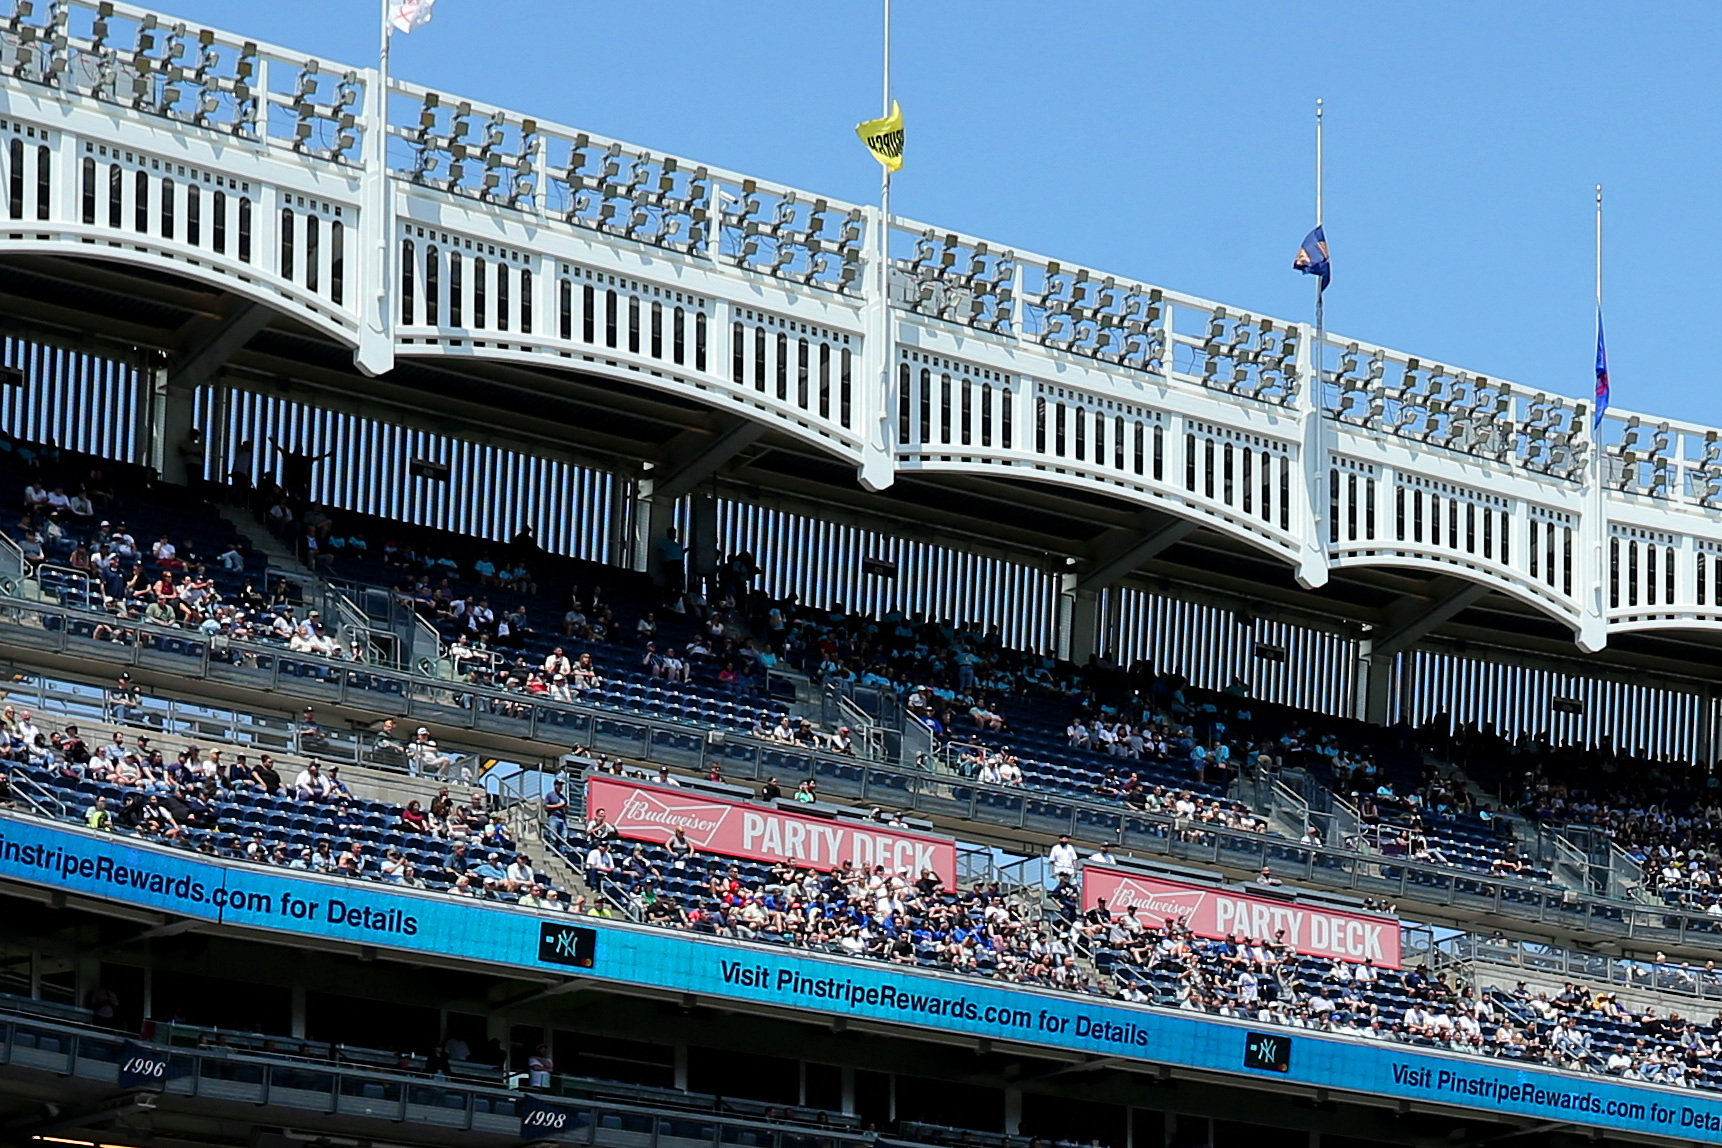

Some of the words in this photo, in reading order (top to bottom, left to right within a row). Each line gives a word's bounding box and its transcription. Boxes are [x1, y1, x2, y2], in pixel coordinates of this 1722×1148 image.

[624, 797, 717, 833] Budweiser
[743, 812, 845, 867] PARTY
[848, 832, 936, 880] DECK
[281, 892, 319, 921] for
[326, 899, 418, 936] Details
[1112, 886, 1195, 923] Budweiser
[1216, 897, 1302, 945] PARTY
[1311, 913, 1383, 960] DECK
[720, 960, 770, 989] Visit
[776, 968, 1031, 1029] PinstripeRewards.com
[1038, 1008, 1068, 1035] for
[1075, 1014, 1149, 1046] Details
[122, 1056, 166, 1077] 1996
[1391, 1062, 1431, 1089] Visit
[1437, 1071, 1645, 1123] PinstripeRewards.com
[1650, 1101, 1677, 1125] for
[523, 1110, 567, 1128] 1998
